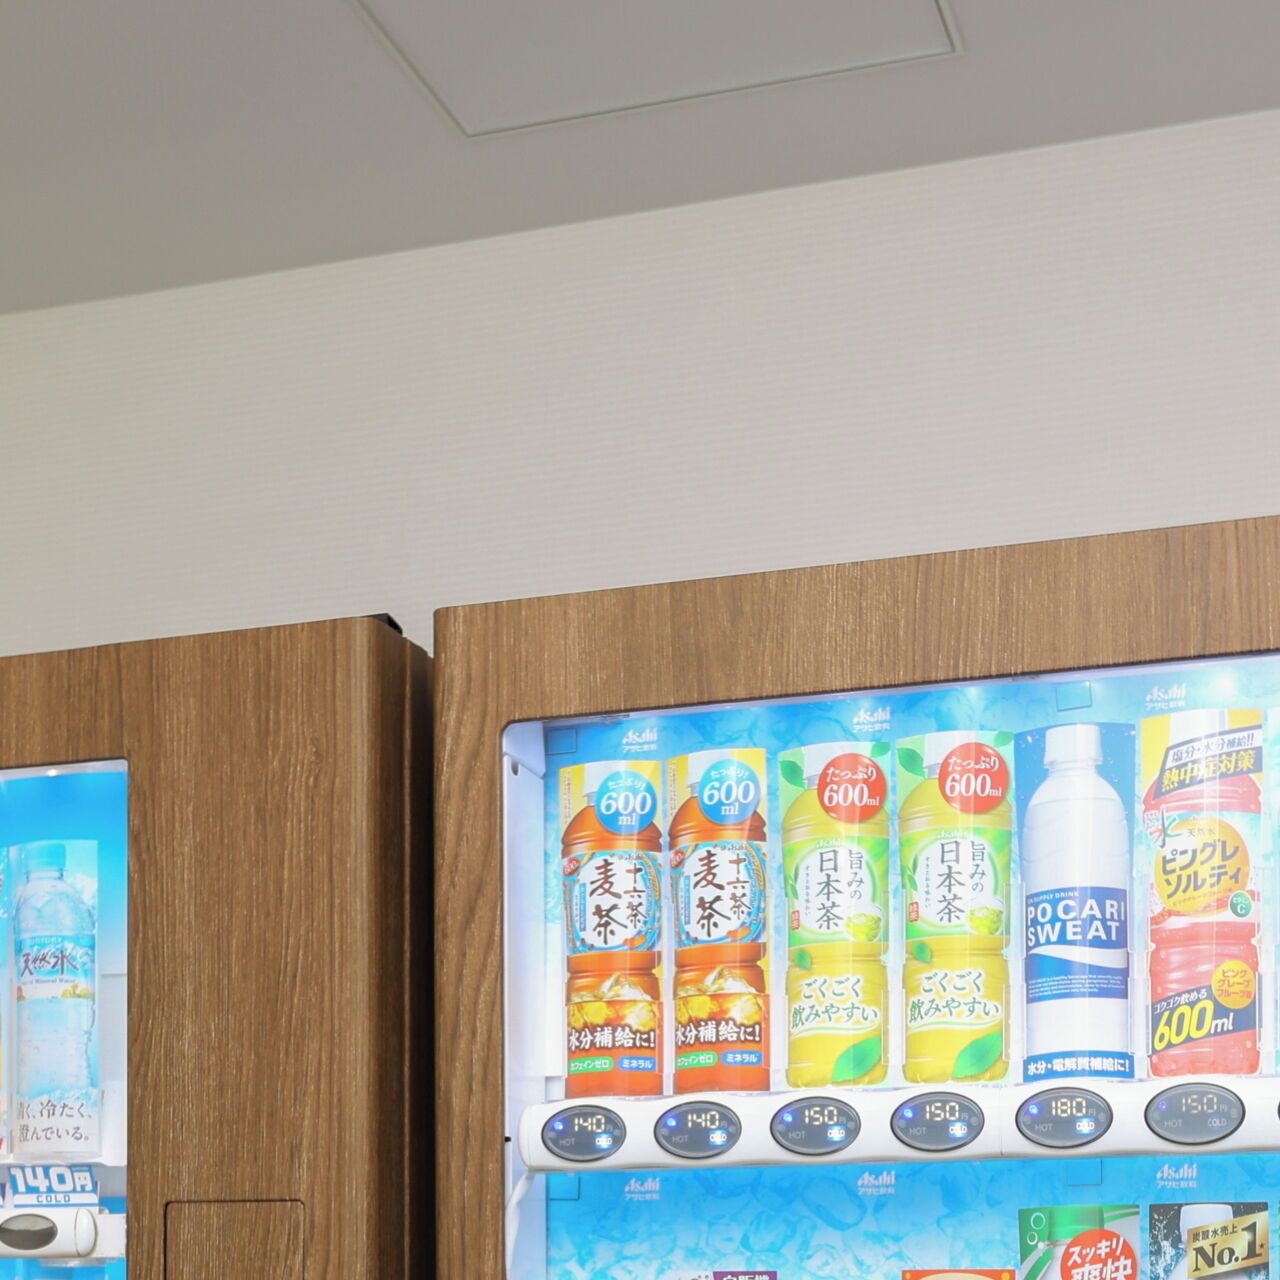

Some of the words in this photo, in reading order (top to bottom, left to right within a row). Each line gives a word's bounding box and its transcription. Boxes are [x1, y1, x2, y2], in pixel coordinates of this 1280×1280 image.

[622, 728, 658, 745] Asahi
[825, 767, 877, 782] たっぷり
[703, 780, 755, 805] 600
[619, 813, 636, 825] ml
[1161, 838, 1240, 877] ピングレ
[848, 849, 865, 901] 旨みの
[1165, 863, 1241, 900] ソルティ
[815, 848, 844, 931] 日本茶
[1027, 898, 1125, 924] POCARI
[1028, 920, 1120, 948] SWEAT
[802, 977, 862, 1000] ごくごく
[791, 1002, 879, 1030] 飲みやすい
[804, 1107, 838, 1125] 150
[1052, 1098, 1087, 1117] 180
[574, 1116, 606, 1132] 140
[10, 1166, 94, 1192] 140円
[1067, 1237, 1126, 1267] スッキリ
[1192, 1220, 1263, 1273] No.1
